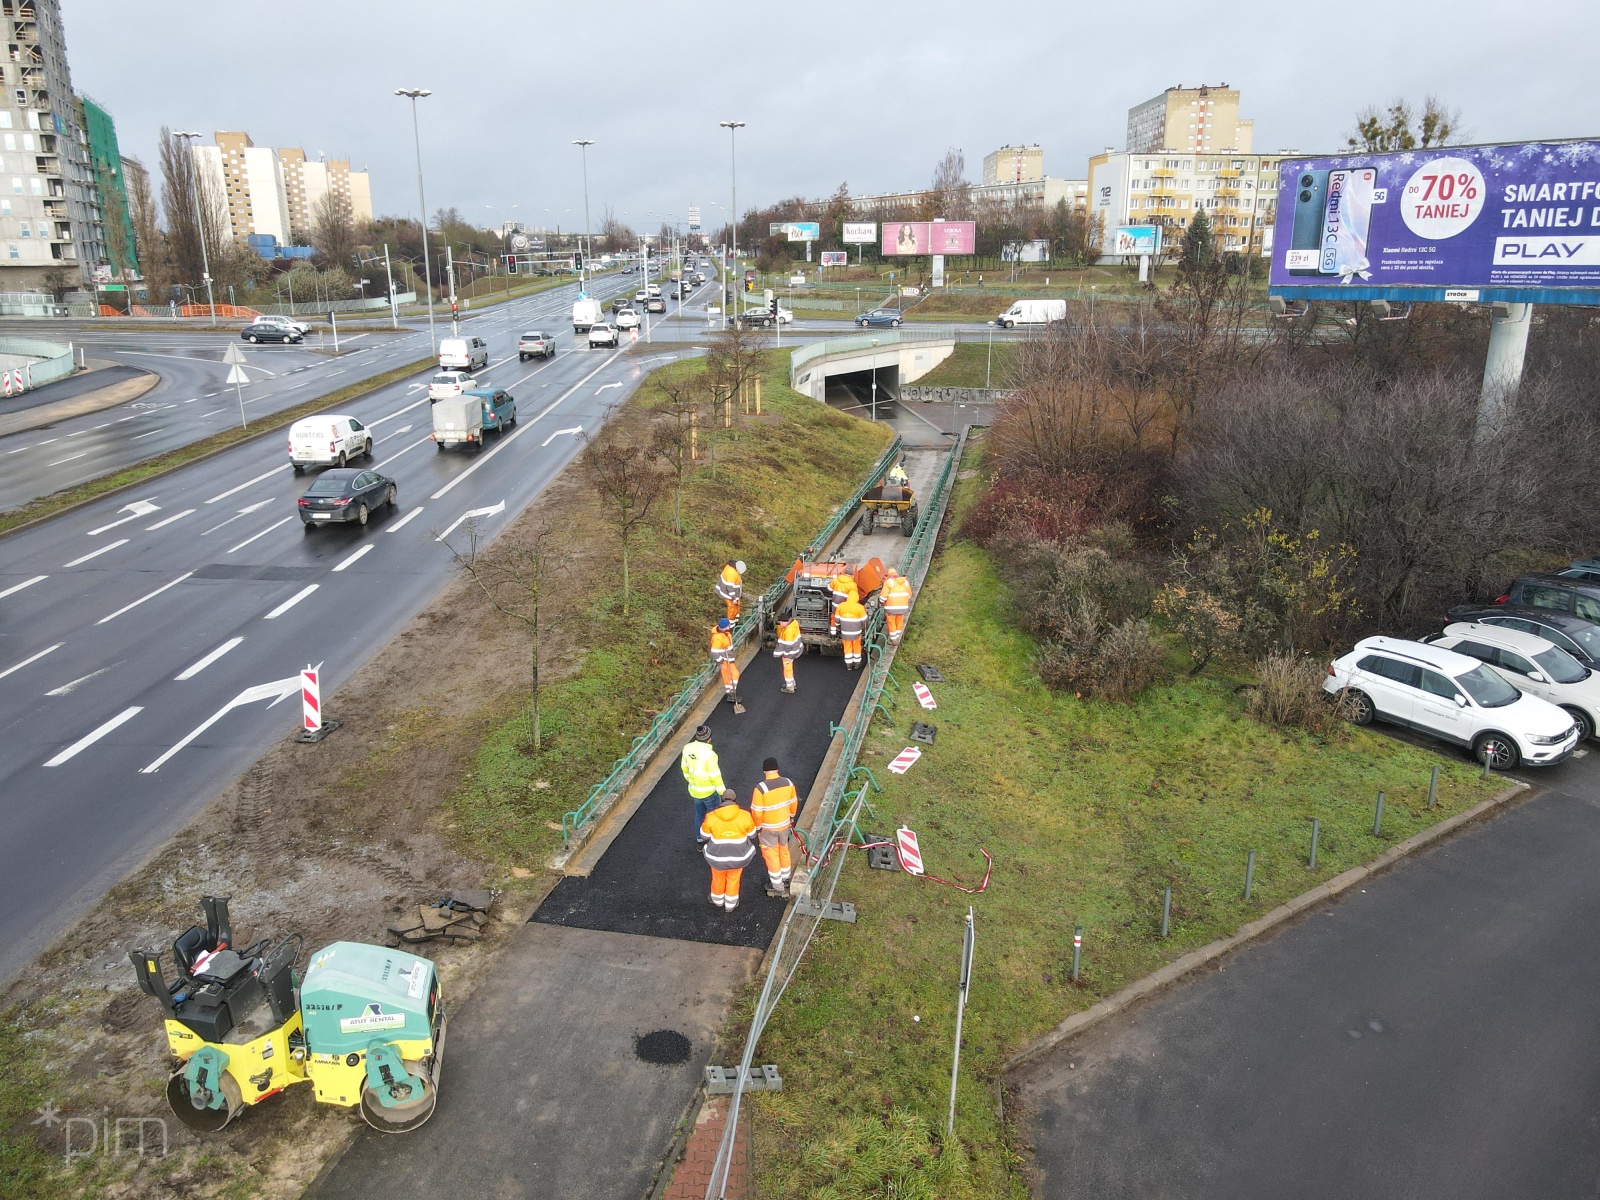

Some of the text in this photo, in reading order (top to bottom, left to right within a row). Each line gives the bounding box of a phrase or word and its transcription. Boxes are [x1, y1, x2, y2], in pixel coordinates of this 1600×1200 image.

[1100, 186, 1112, 197] 12
[1409, 173, 1478, 201] DO 70%
[1374, 191, 1385, 200] 5G
[1414, 203, 1470, 219] TANIEJ
[1501, 207, 1584, 228] TANIEJ
[1325, 174, 1346, 266] Redmi 13C 5G
[1501, 243, 1585, 258] PLAY
